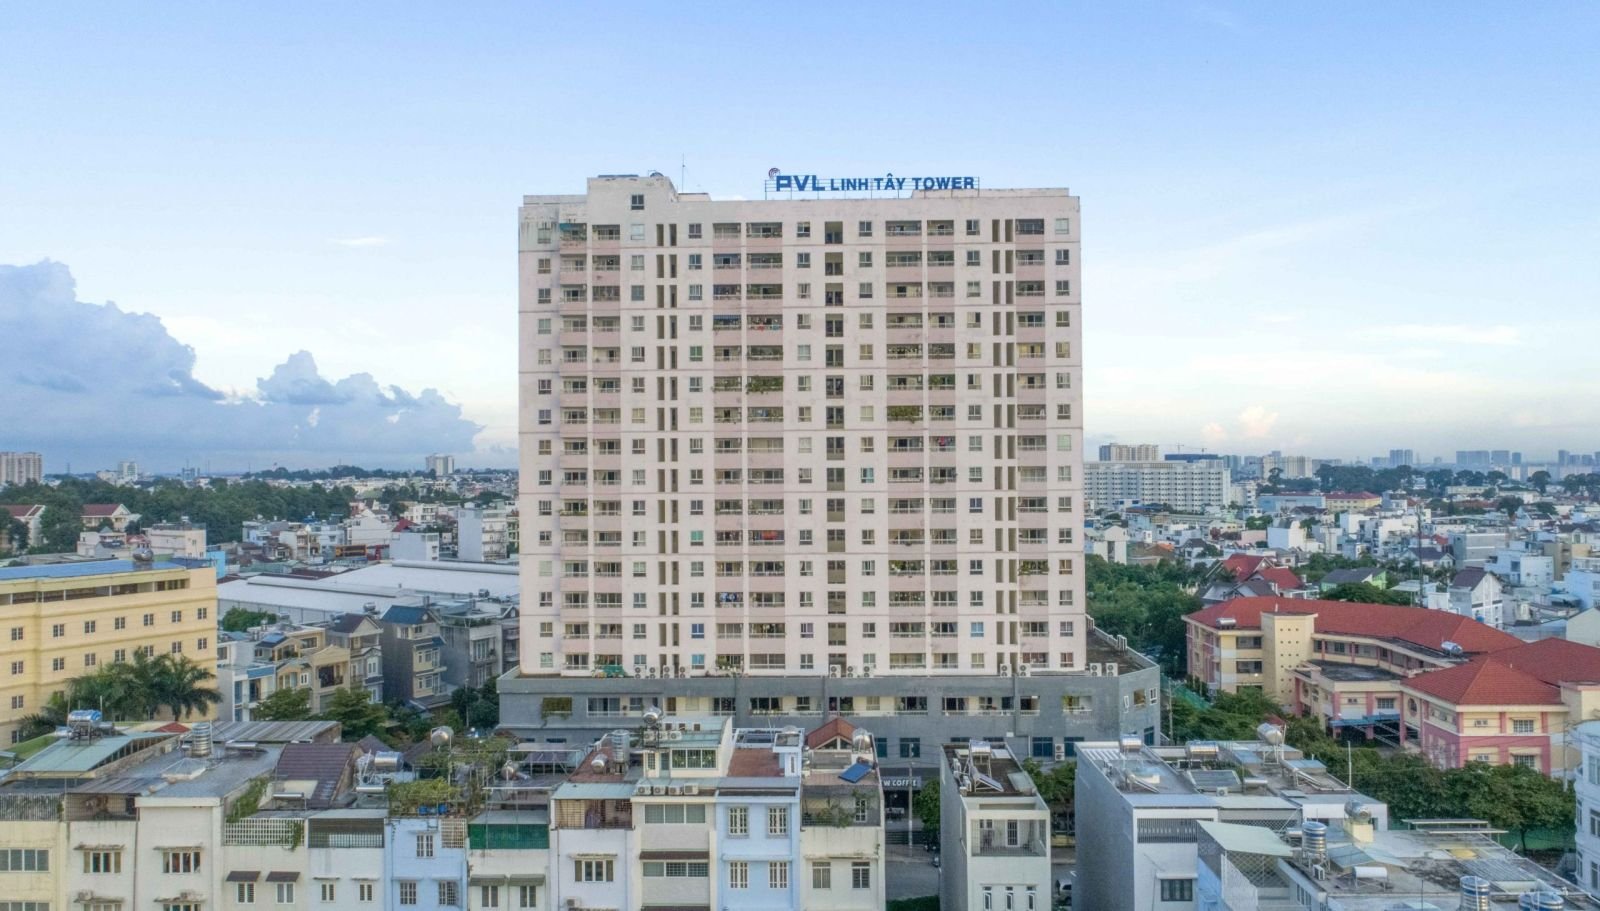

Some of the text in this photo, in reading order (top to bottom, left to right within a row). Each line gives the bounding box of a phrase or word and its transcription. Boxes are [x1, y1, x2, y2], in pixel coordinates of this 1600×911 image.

[776, 173, 974, 191] PVL LINH TÂY TOWER
[892, 779, 917, 787] COFFE
